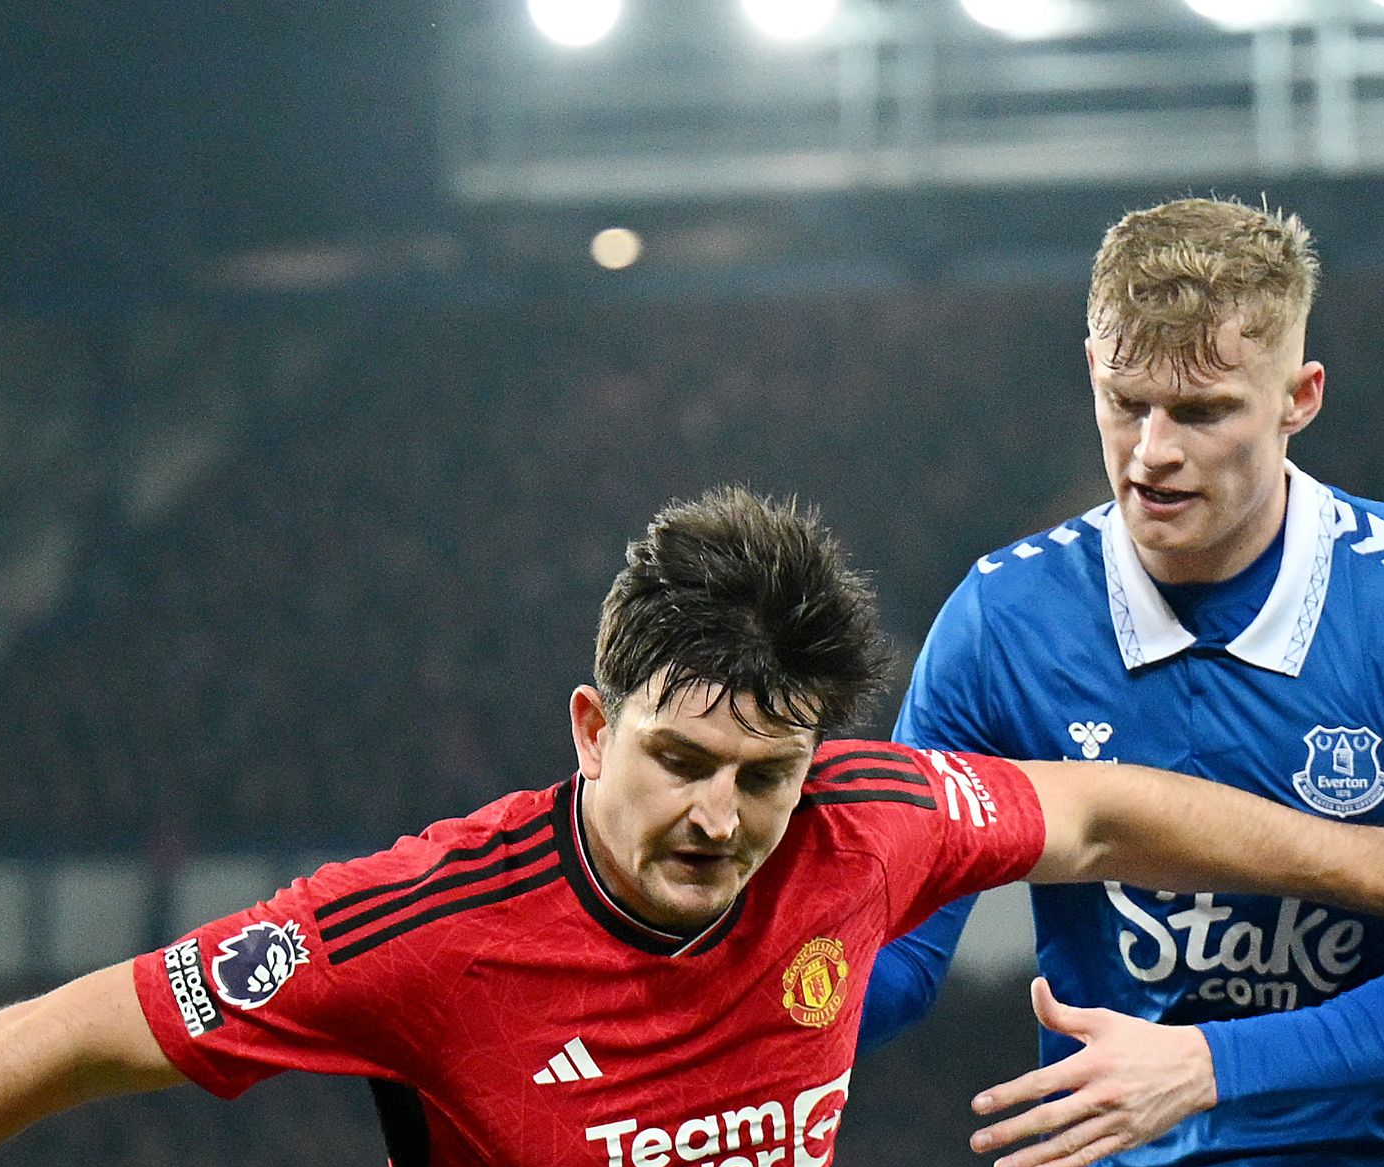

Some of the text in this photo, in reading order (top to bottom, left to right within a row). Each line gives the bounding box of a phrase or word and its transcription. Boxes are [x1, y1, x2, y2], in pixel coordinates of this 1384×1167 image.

[1318, 775, 1368, 789] Everton
[786, 941, 840, 983] MANCHESTER
[1104, 881, 1364, 993] Stake
[169, 971, 205, 1038] racism
[179, 939, 216, 1022] No room
[802, 995, 842, 1022] UNITED
